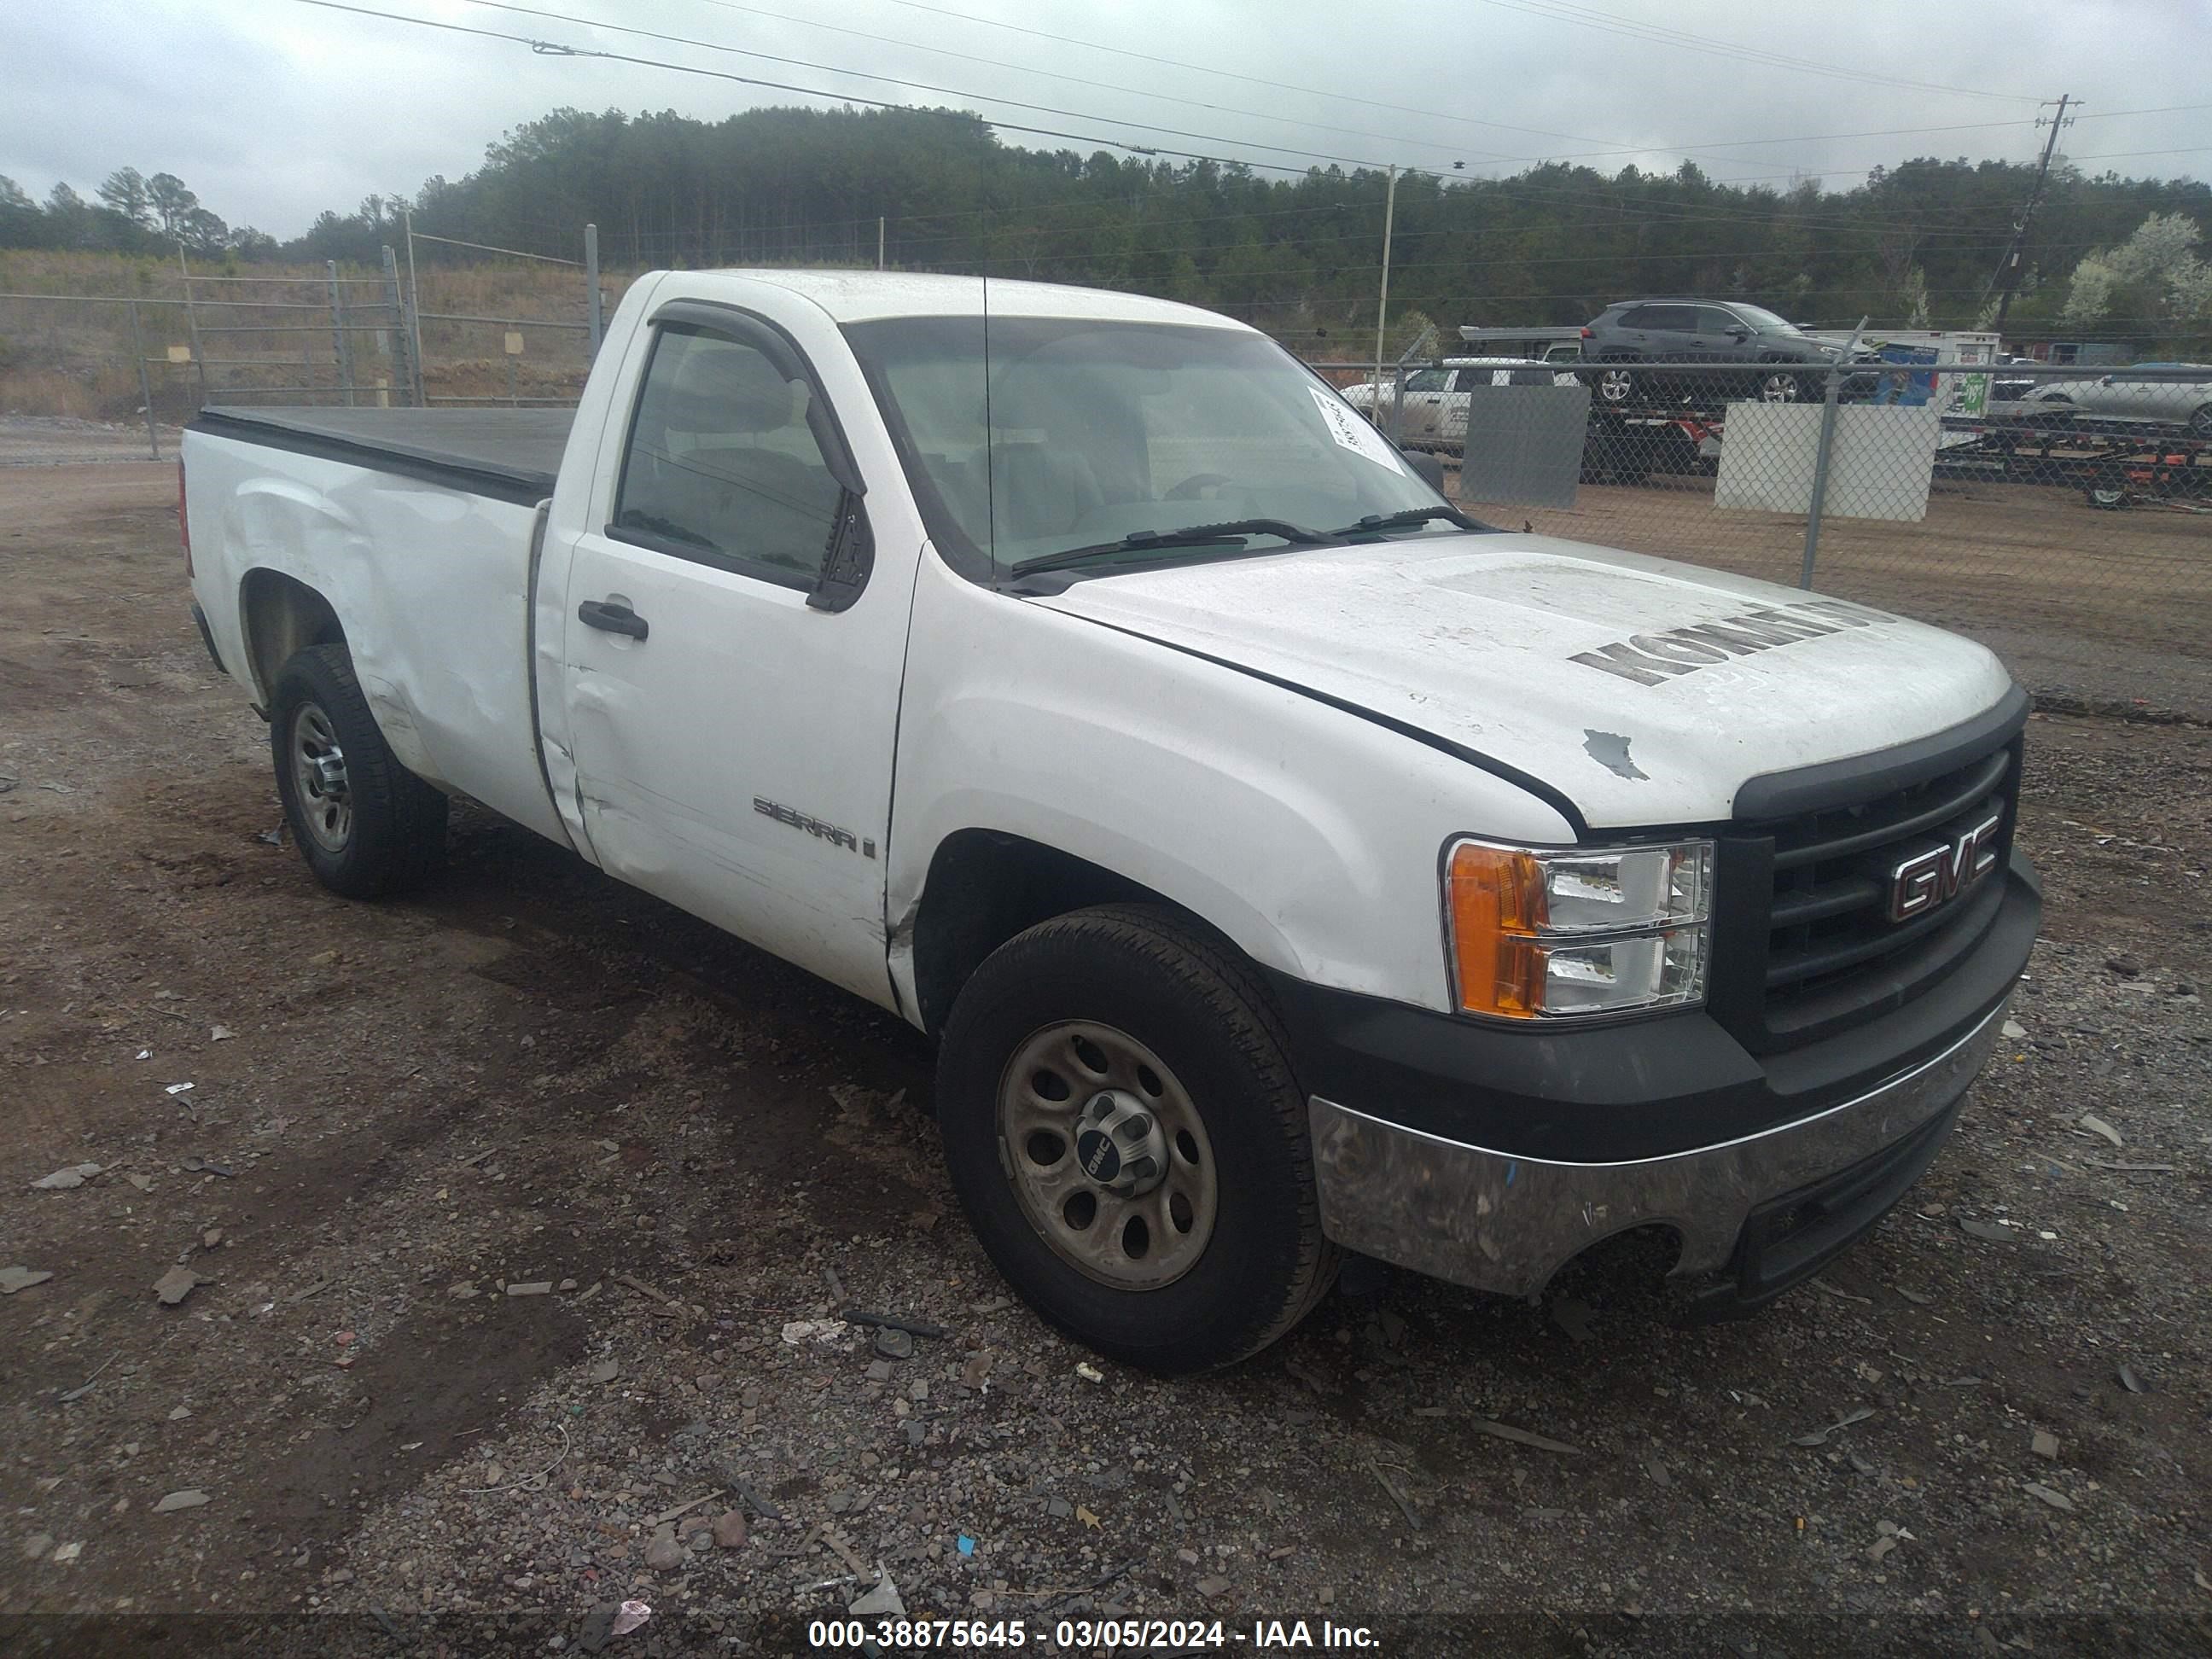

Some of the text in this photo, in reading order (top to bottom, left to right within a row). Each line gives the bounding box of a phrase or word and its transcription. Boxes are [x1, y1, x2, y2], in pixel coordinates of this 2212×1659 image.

[753, 795, 857, 853] SIERRA
[1891, 815, 1999, 924] GMC
[1087, 1137, 1110, 1175] GMC
